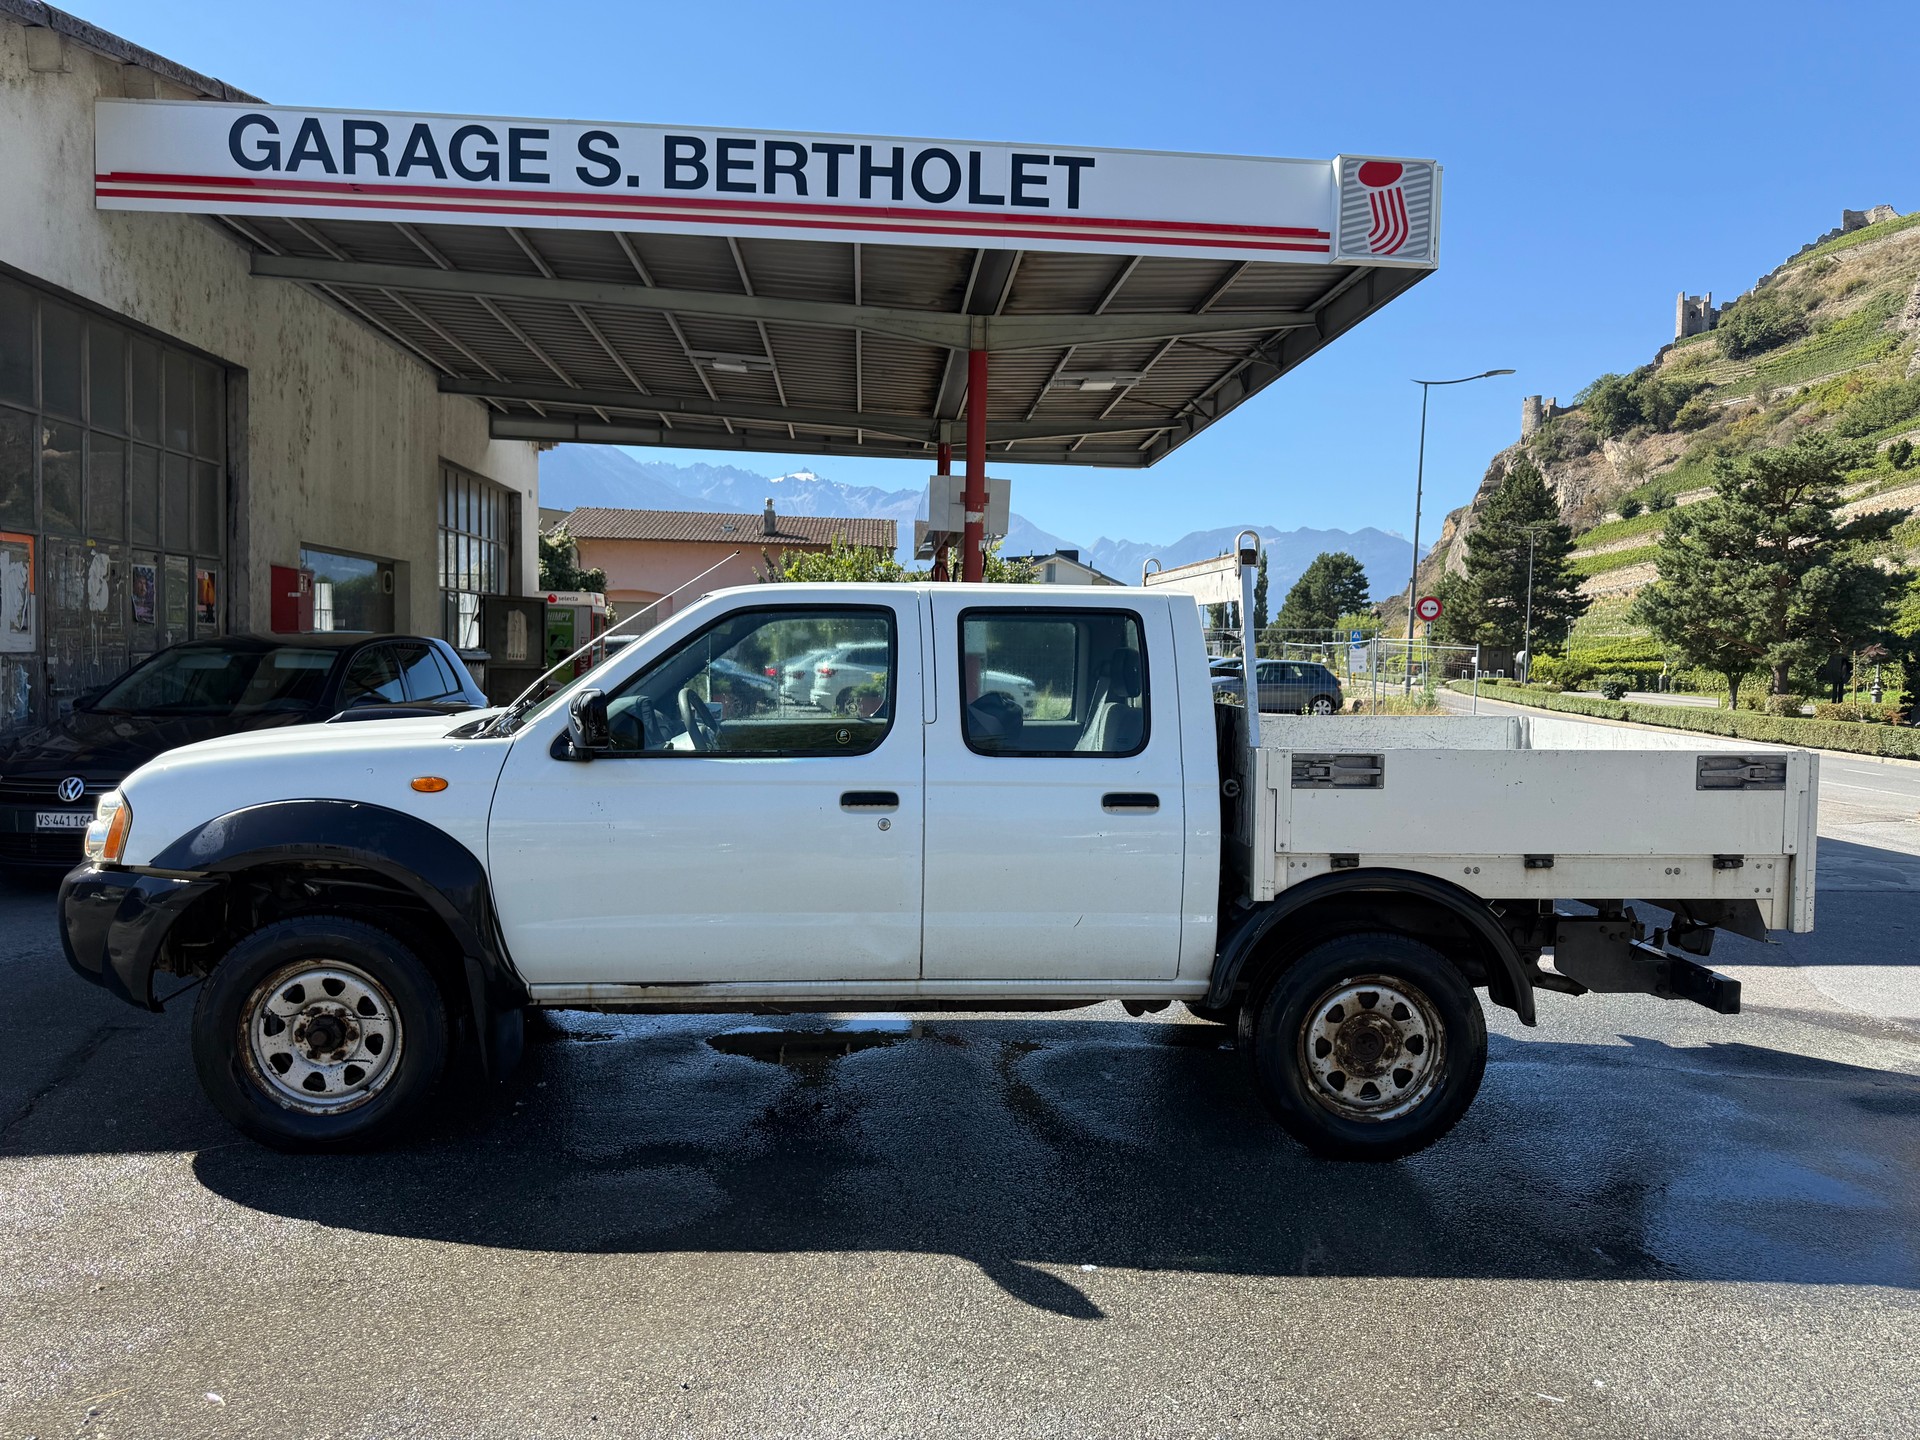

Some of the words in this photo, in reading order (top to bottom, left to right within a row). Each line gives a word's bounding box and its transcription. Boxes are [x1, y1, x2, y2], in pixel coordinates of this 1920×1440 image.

[229, 114, 550, 183] GARAGE
[576, 131, 640, 188] S.
[664, 135, 1095, 209] BERTHOLET
[548, 612, 571, 621] HIMPY
